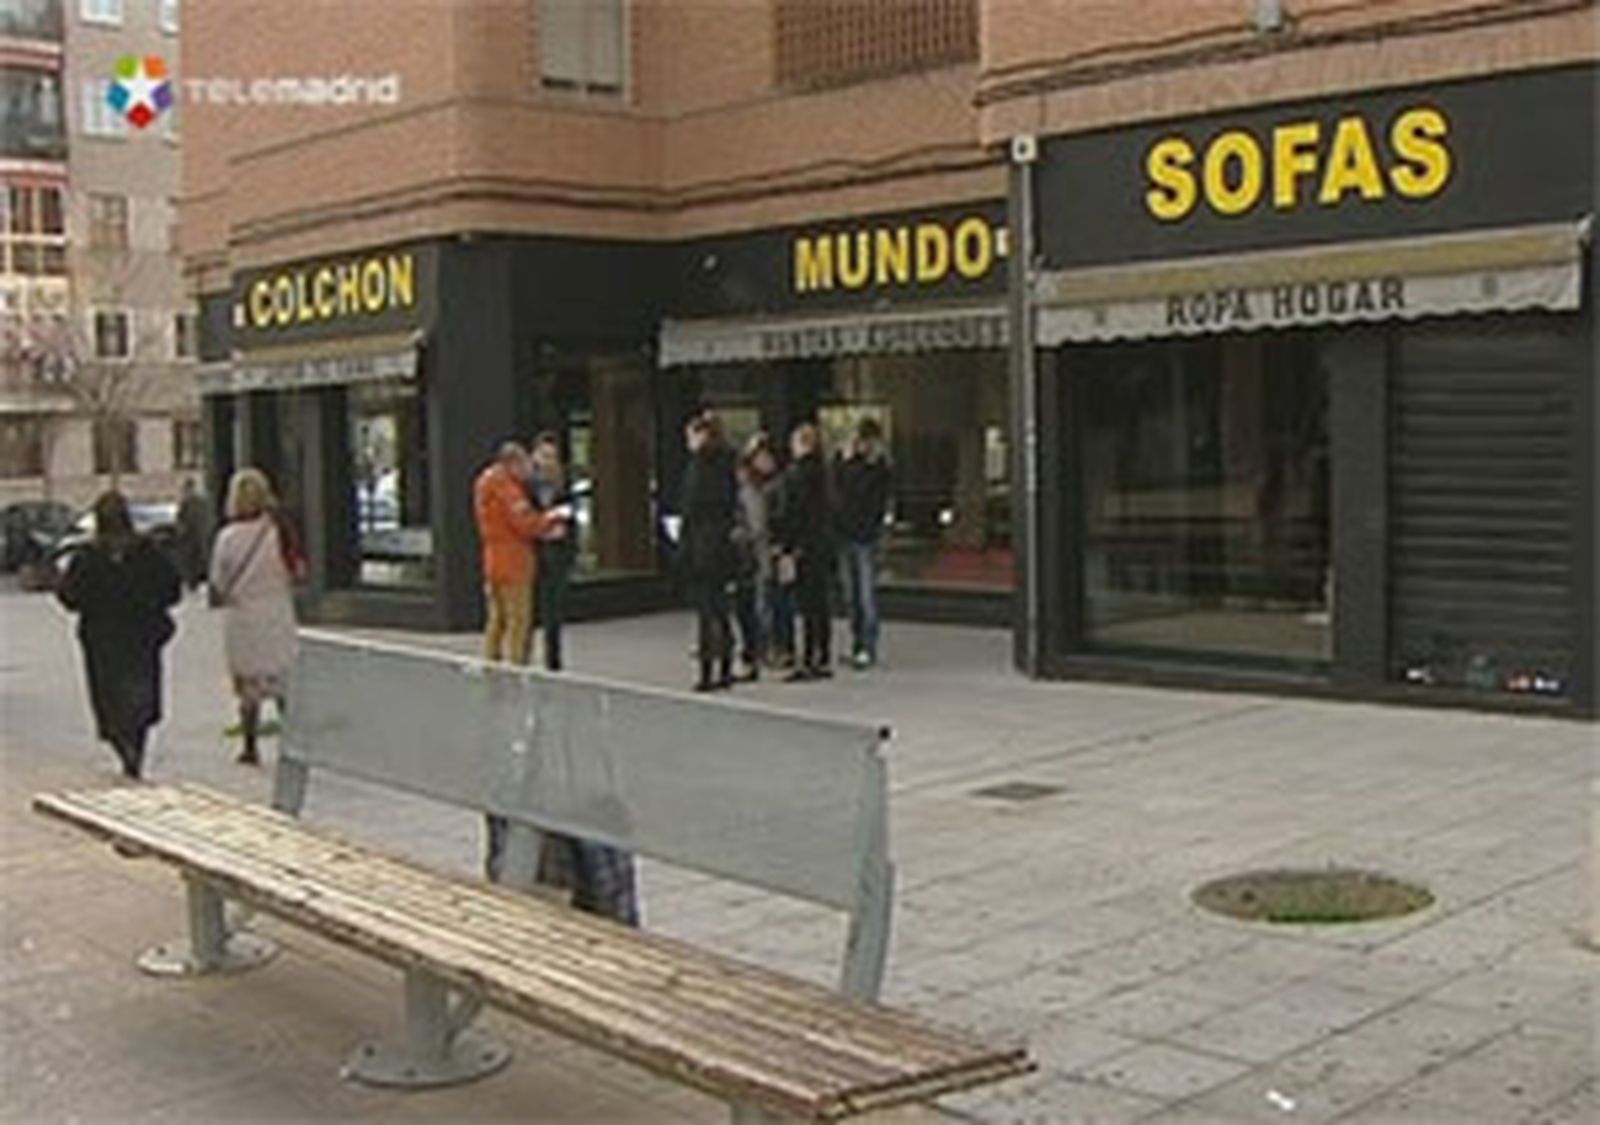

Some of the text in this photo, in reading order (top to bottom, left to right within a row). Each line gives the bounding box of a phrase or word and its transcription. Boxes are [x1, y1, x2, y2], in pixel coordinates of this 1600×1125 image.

[1146, 108, 1452, 220] SOFAS
[251, 255, 413, 327] COLCHON
[793, 218, 990, 292] MUNDO
[1166, 277, 1405, 326] ROPA HOGAR
